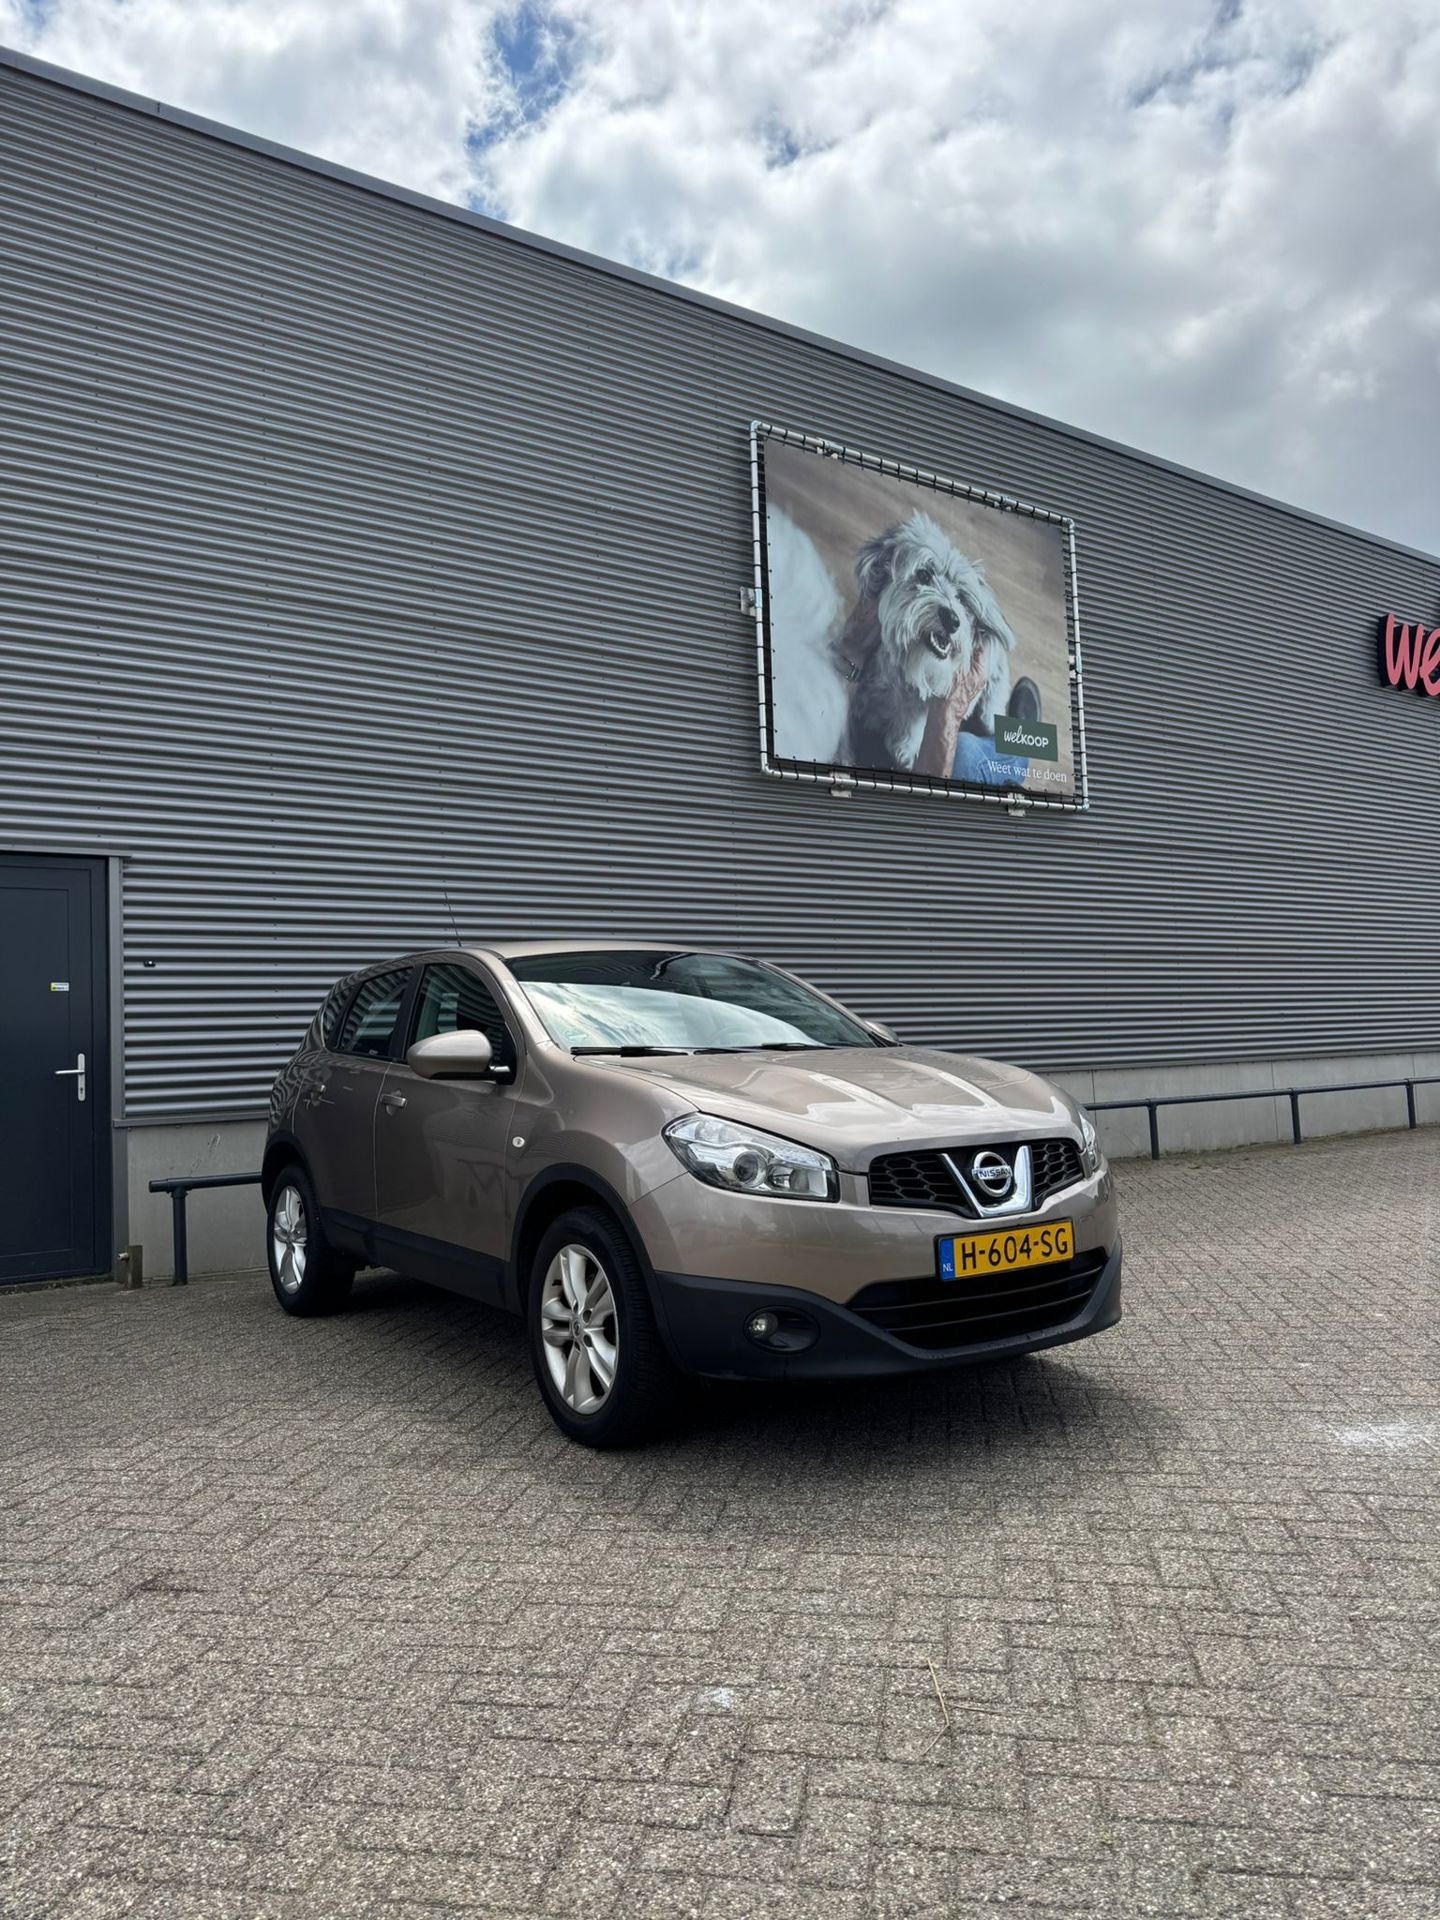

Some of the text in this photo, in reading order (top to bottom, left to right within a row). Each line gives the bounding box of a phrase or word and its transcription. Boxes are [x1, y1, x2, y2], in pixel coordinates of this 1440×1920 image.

[987, 761, 1067, 783] Weet wat te doen
[979, 1168, 1011, 1178] NISSAN
[942, 1227, 1068, 1272] NL H-604-SG
